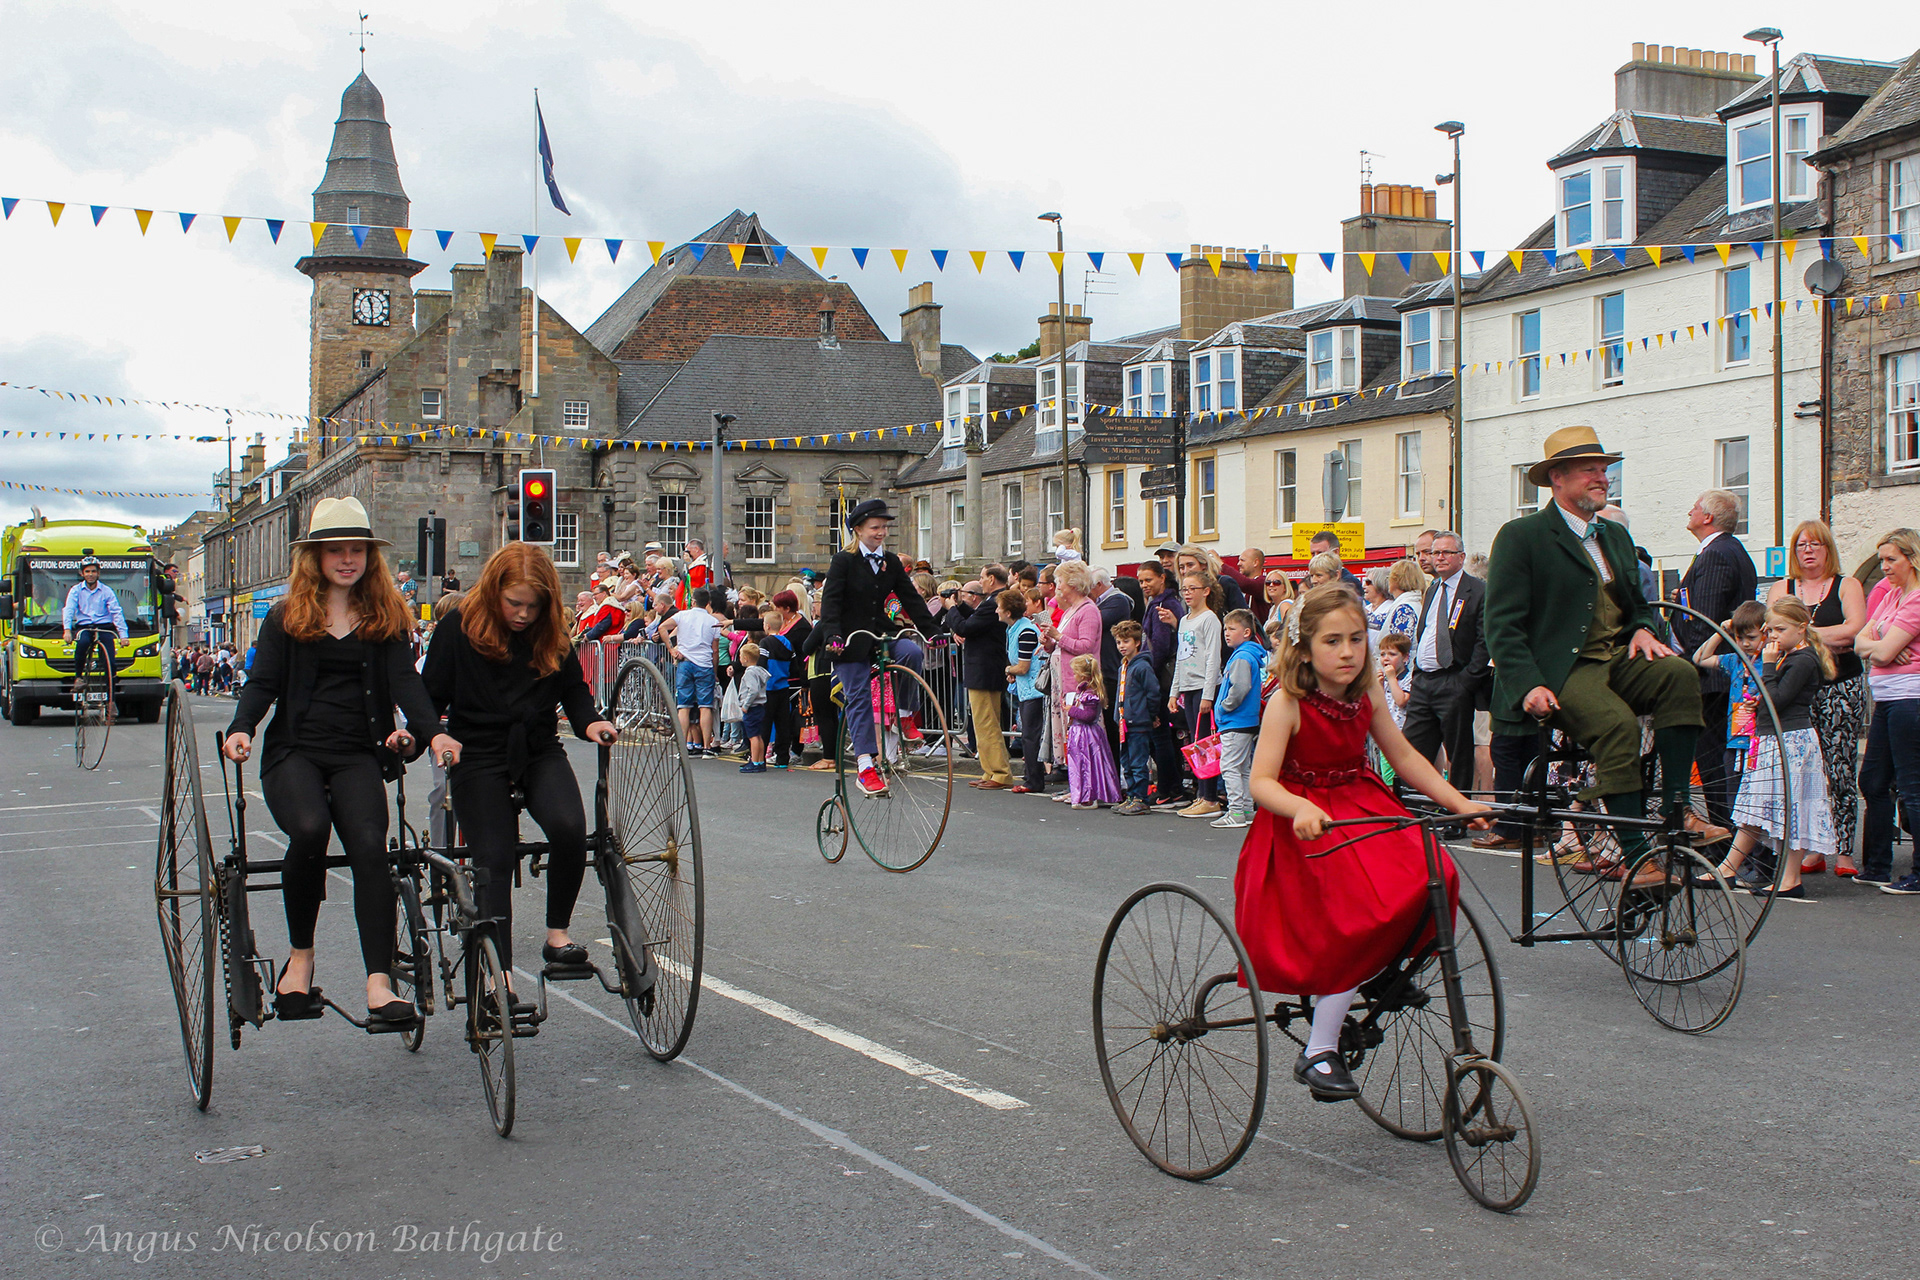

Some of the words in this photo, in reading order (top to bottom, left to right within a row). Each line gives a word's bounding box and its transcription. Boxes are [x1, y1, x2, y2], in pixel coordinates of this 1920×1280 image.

[1100, 417, 1121, 425] Sports
[30, 560, 58, 569] CAUTION:
[99, 561, 121, 569] ORKING
[122, 561, 130, 569] AT
[130, 561, 147, 569] REAR
[1770, 550, 1784, 574] P
